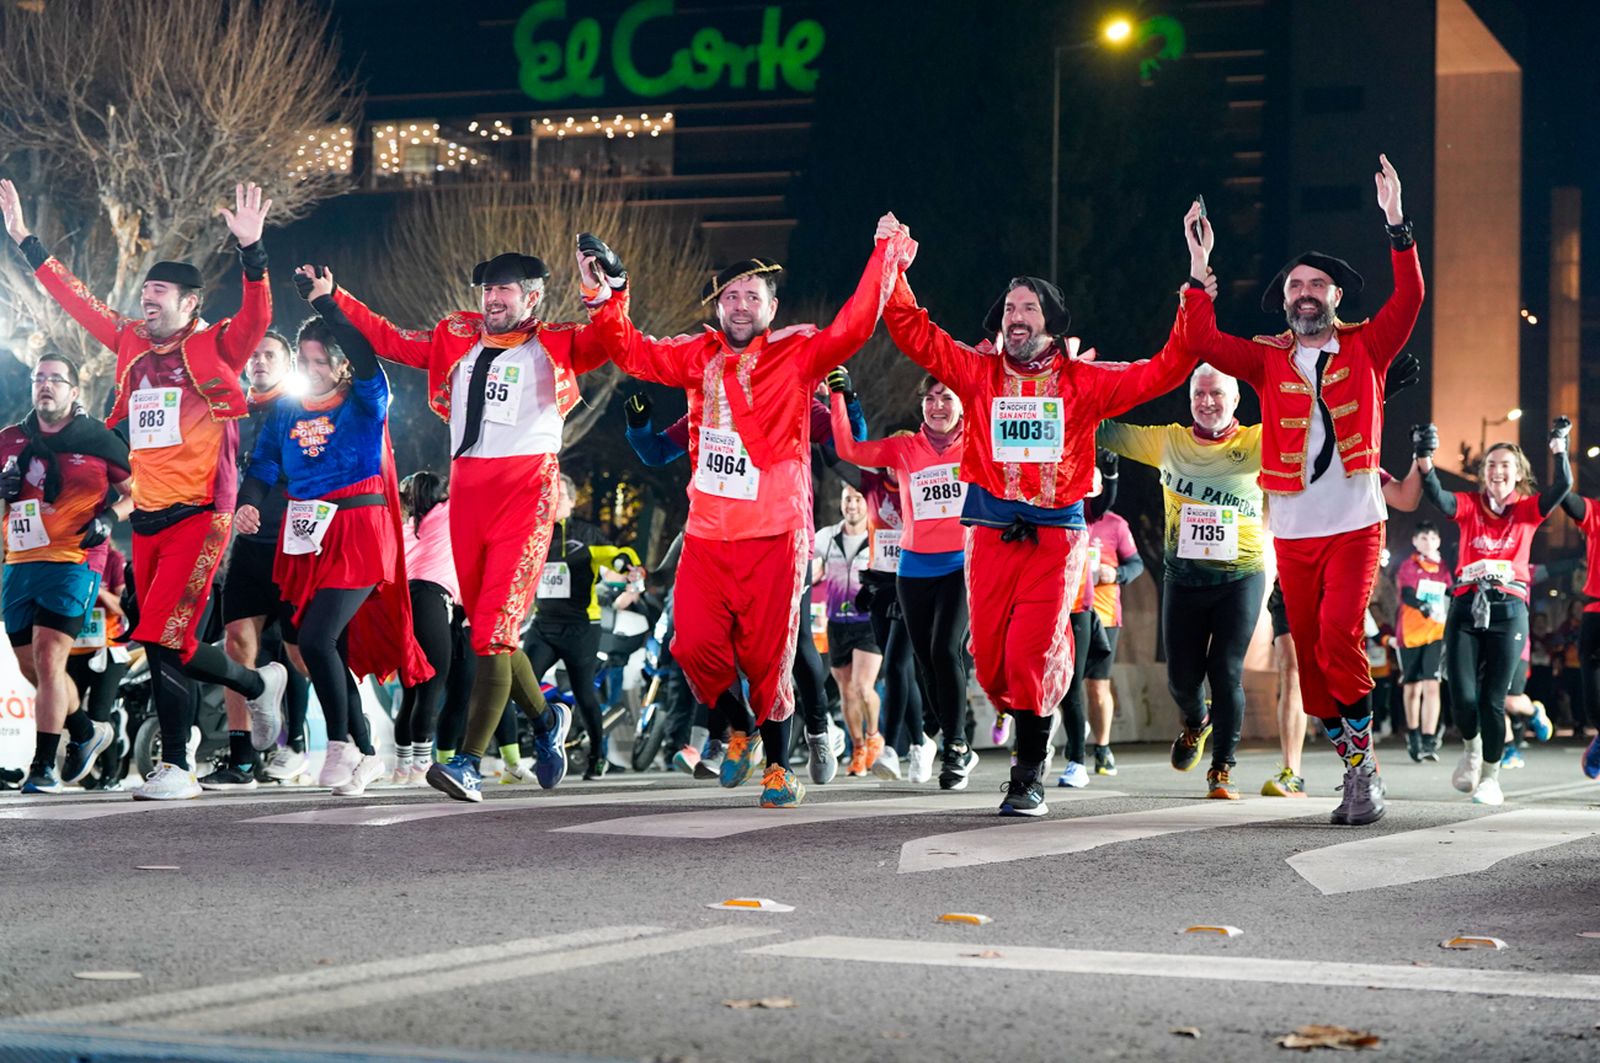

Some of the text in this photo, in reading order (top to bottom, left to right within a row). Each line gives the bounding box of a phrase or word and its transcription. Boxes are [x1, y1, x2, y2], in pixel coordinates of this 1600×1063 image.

[514, 0, 826, 101] El Corte
[486, 382, 509, 402] 35
[139, 409, 165, 428] 883
[296, 416, 330, 430] SUPER
[999, 412, 1012, 420] SAN
[290, 424, 335, 440] POWER
[1000, 420, 1055, 440] 14035
[299, 435, 329, 448] GIRL
[706, 452, 746, 477] 4964
[922, 482, 962, 502] 2889
[1176, 478, 1193, 497] LA
[1201, 486, 1257, 518] PANDERA
[1191, 524, 1225, 542] 7135
[884, 545, 902, 558] 148
[83, 622, 97, 634] 68
